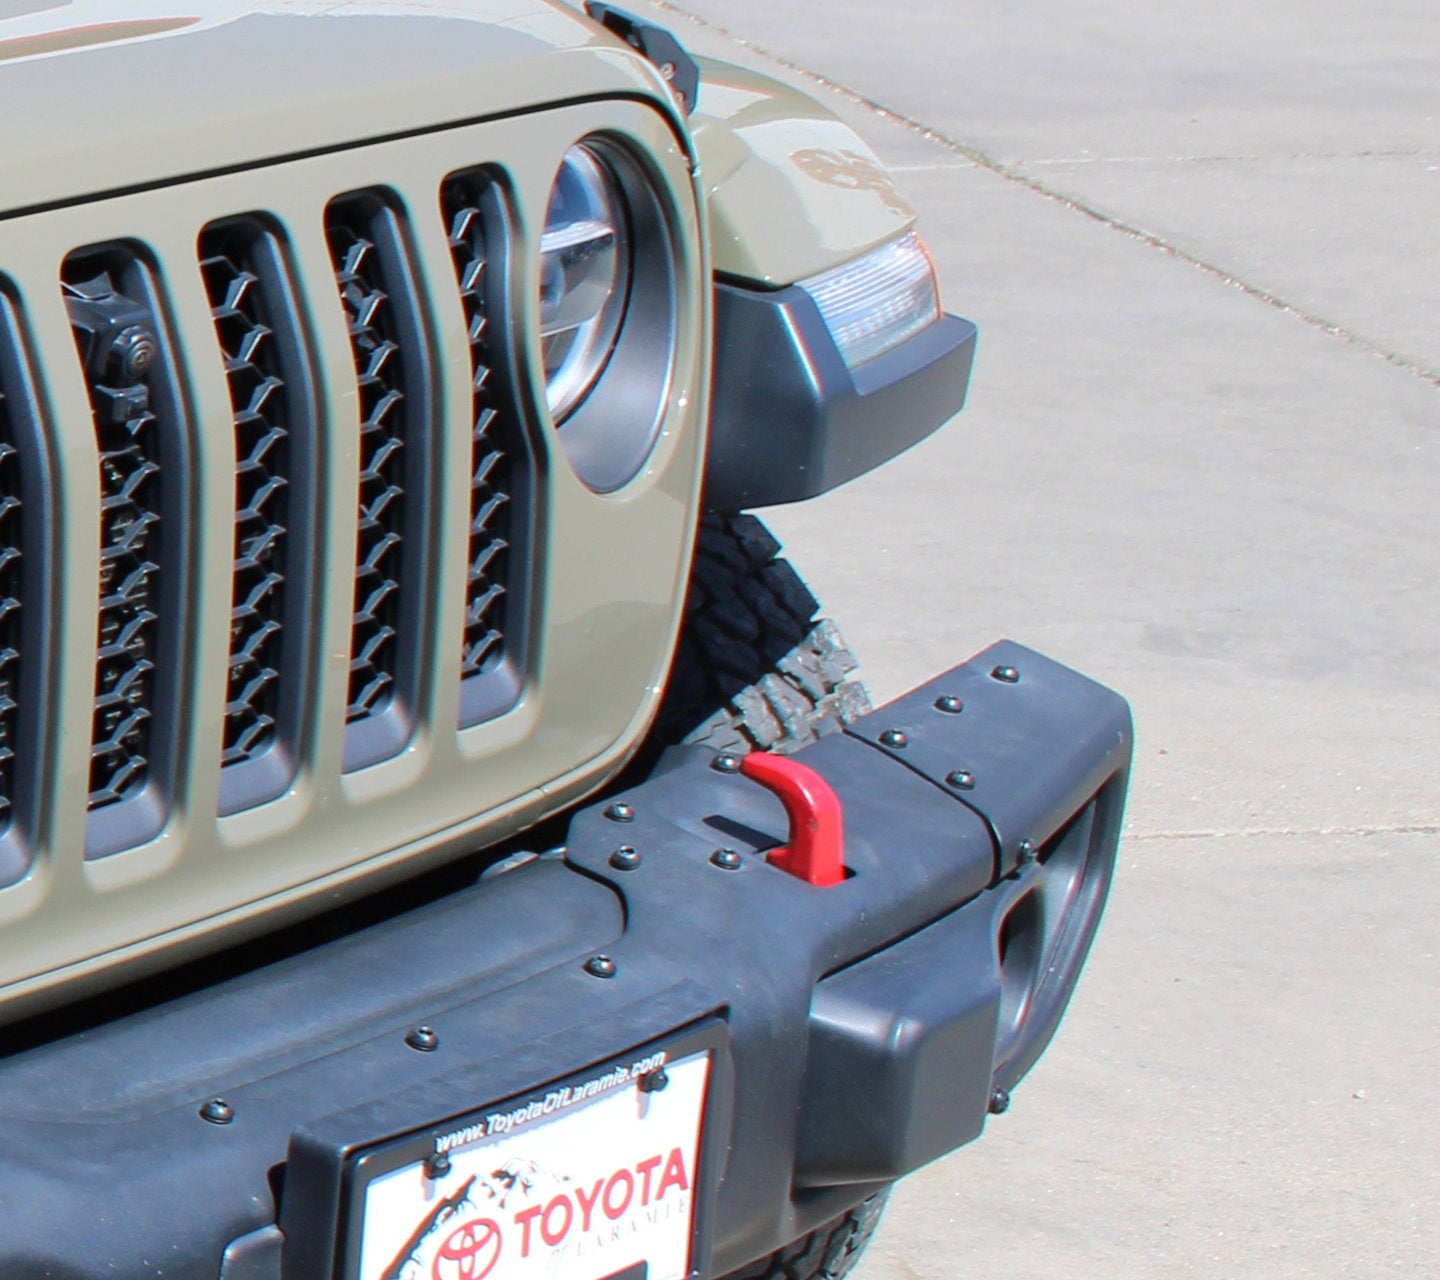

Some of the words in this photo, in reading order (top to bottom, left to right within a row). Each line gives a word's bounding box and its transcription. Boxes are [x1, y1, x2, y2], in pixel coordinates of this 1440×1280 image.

[436, 1051, 667, 1154] www.ToyotaOfLaramie.com
[514, 1147, 688, 1258] TOYOTA
[576, 1196, 687, 1258] LARAMIE
